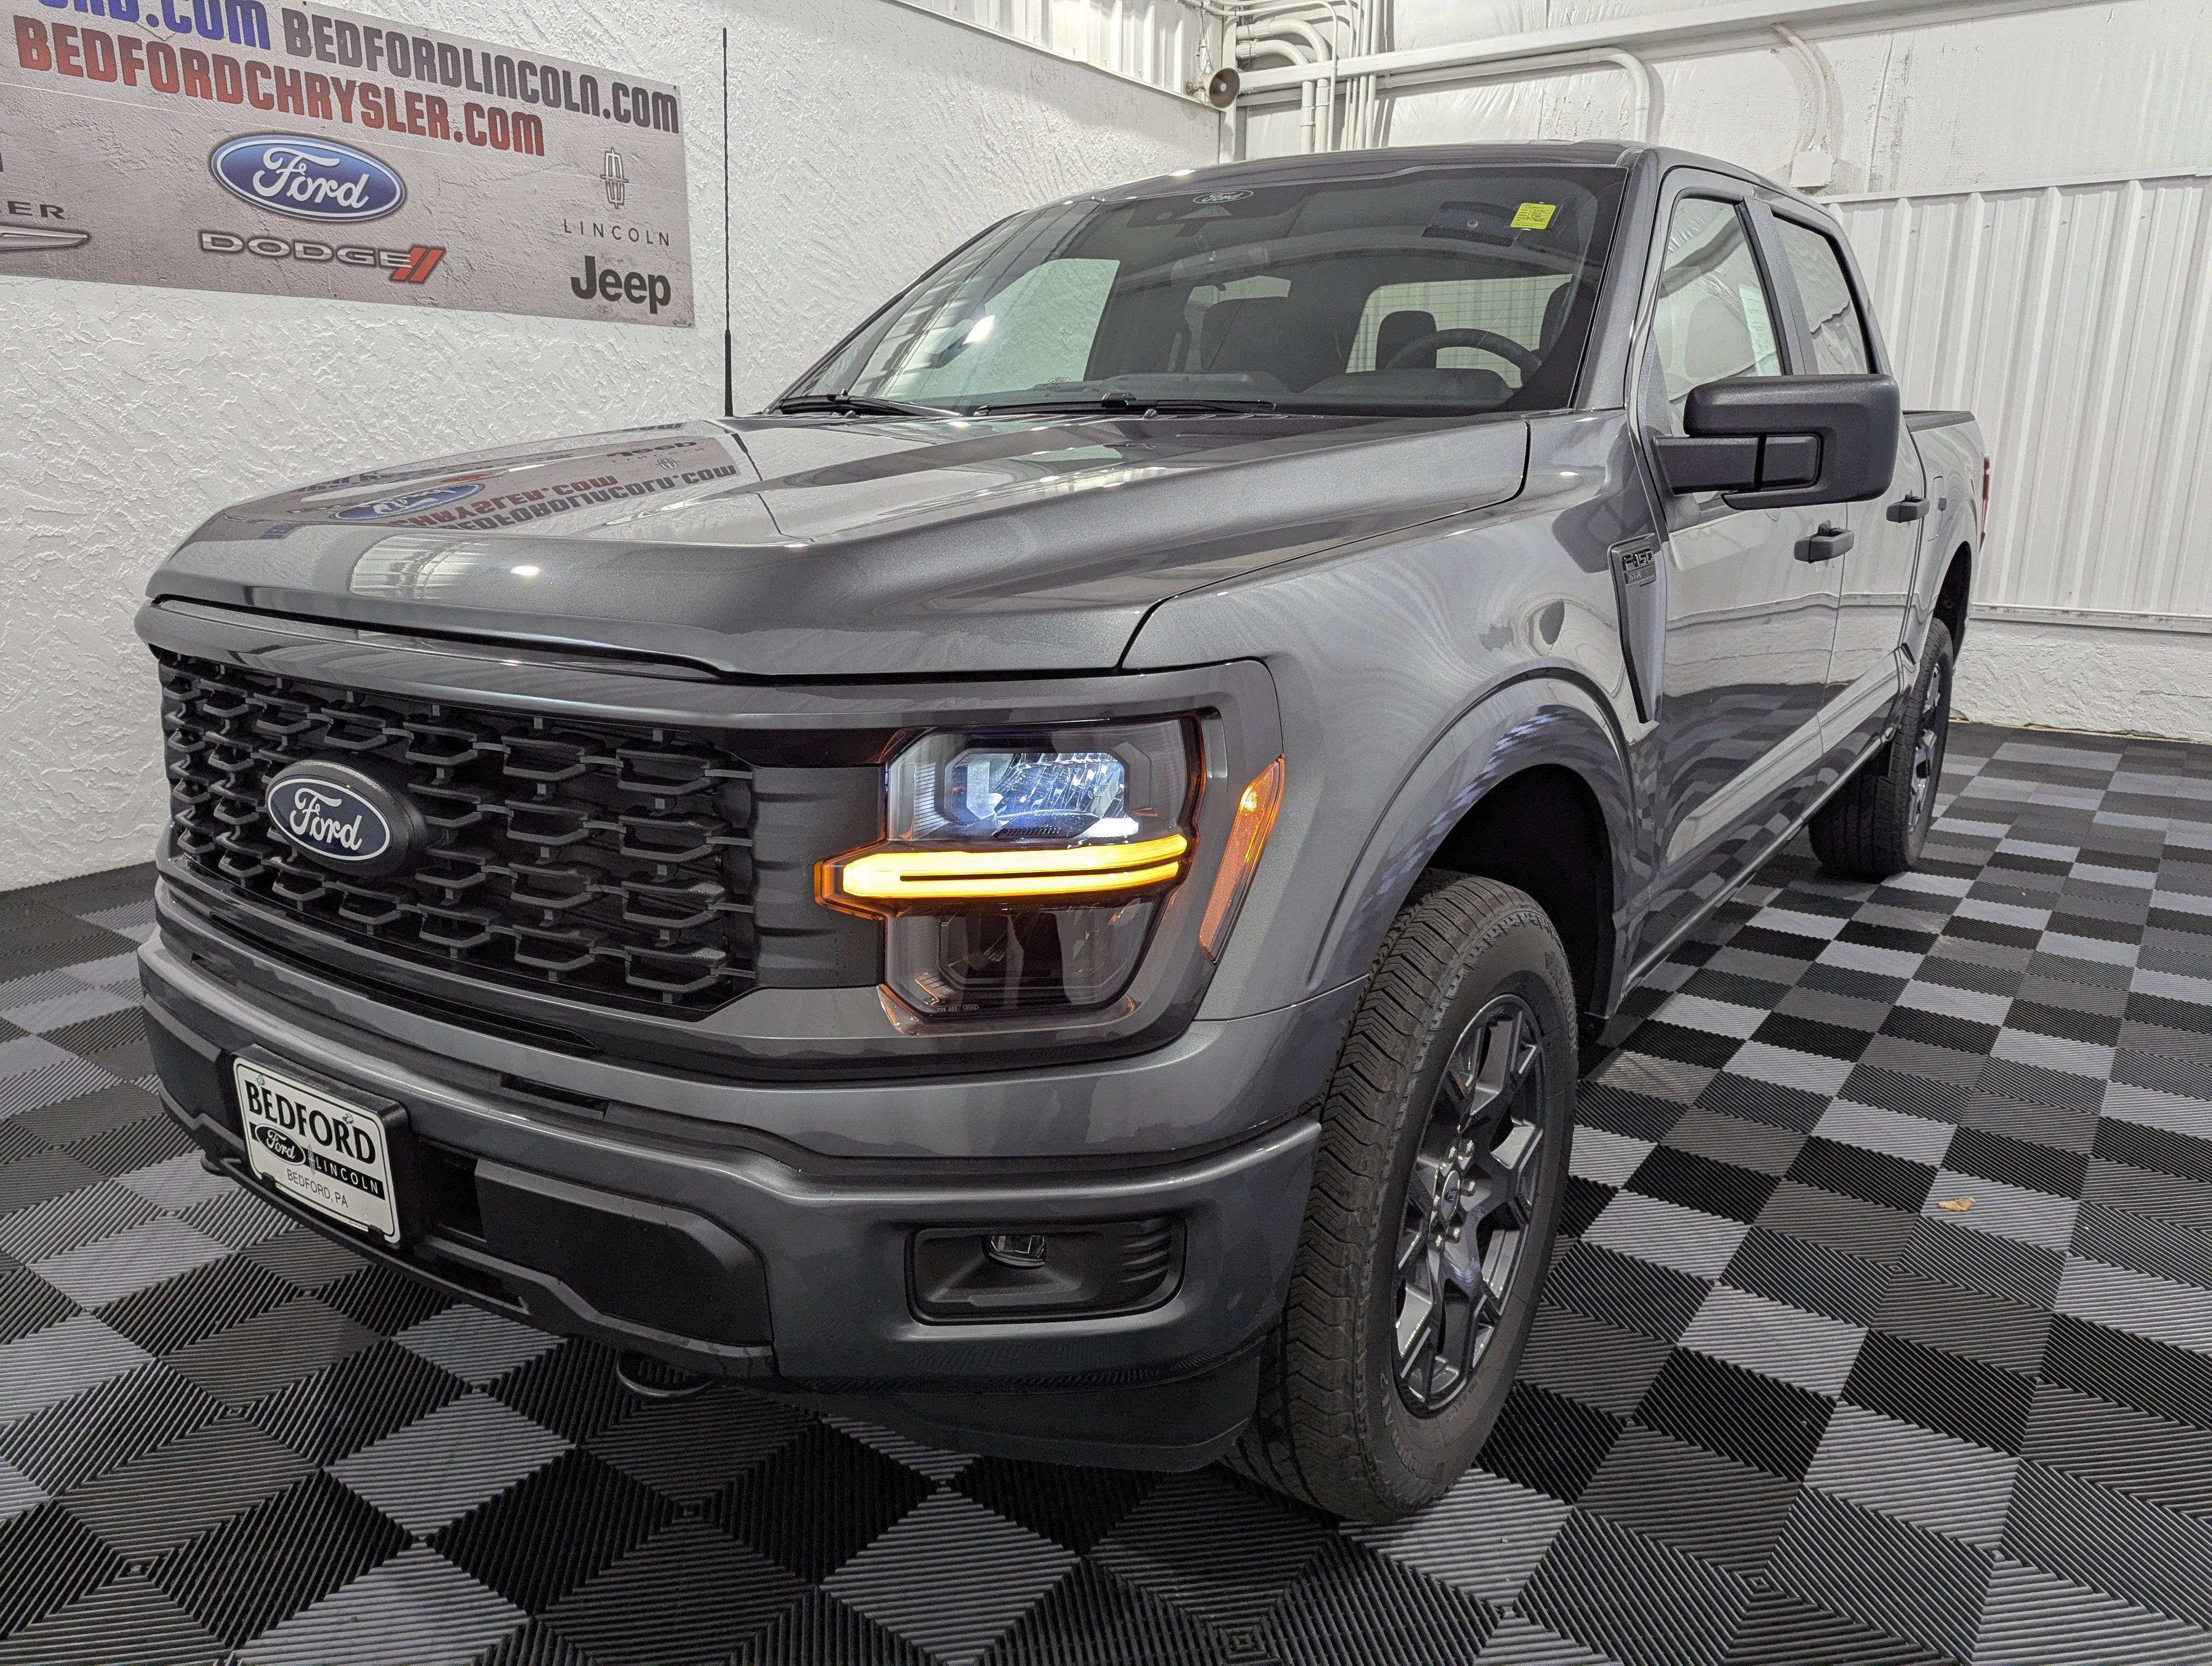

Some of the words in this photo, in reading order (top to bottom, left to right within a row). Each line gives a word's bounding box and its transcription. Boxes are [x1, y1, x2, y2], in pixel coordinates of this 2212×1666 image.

[14, 15, 545, 157] BEDFORDCHRYSLER.COM
[282, 8, 679, 134] BEDFORDLINCOLN.COM
[252, 147, 370, 209] Ford
[1201, 191, 1244, 202] Ford
[0, 200, 66, 220] ER
[564, 218, 670, 247] LINCOLN
[202, 232, 412, 268] DODGE
[571, 255, 671, 315] Jeep
[1624, 550, 1654, 570] F-150
[1629, 571, 1642, 580] STX
[289, 787, 363, 850] Ford
[244, 1079, 376, 1164] BEDFORD
[266, 1129, 295, 1160] Ford
[316, 1156, 378, 1194] LINCOLN
[287, 1168, 333, 1203] BEDFORD,
[335, 1191, 349, 1208] PA
